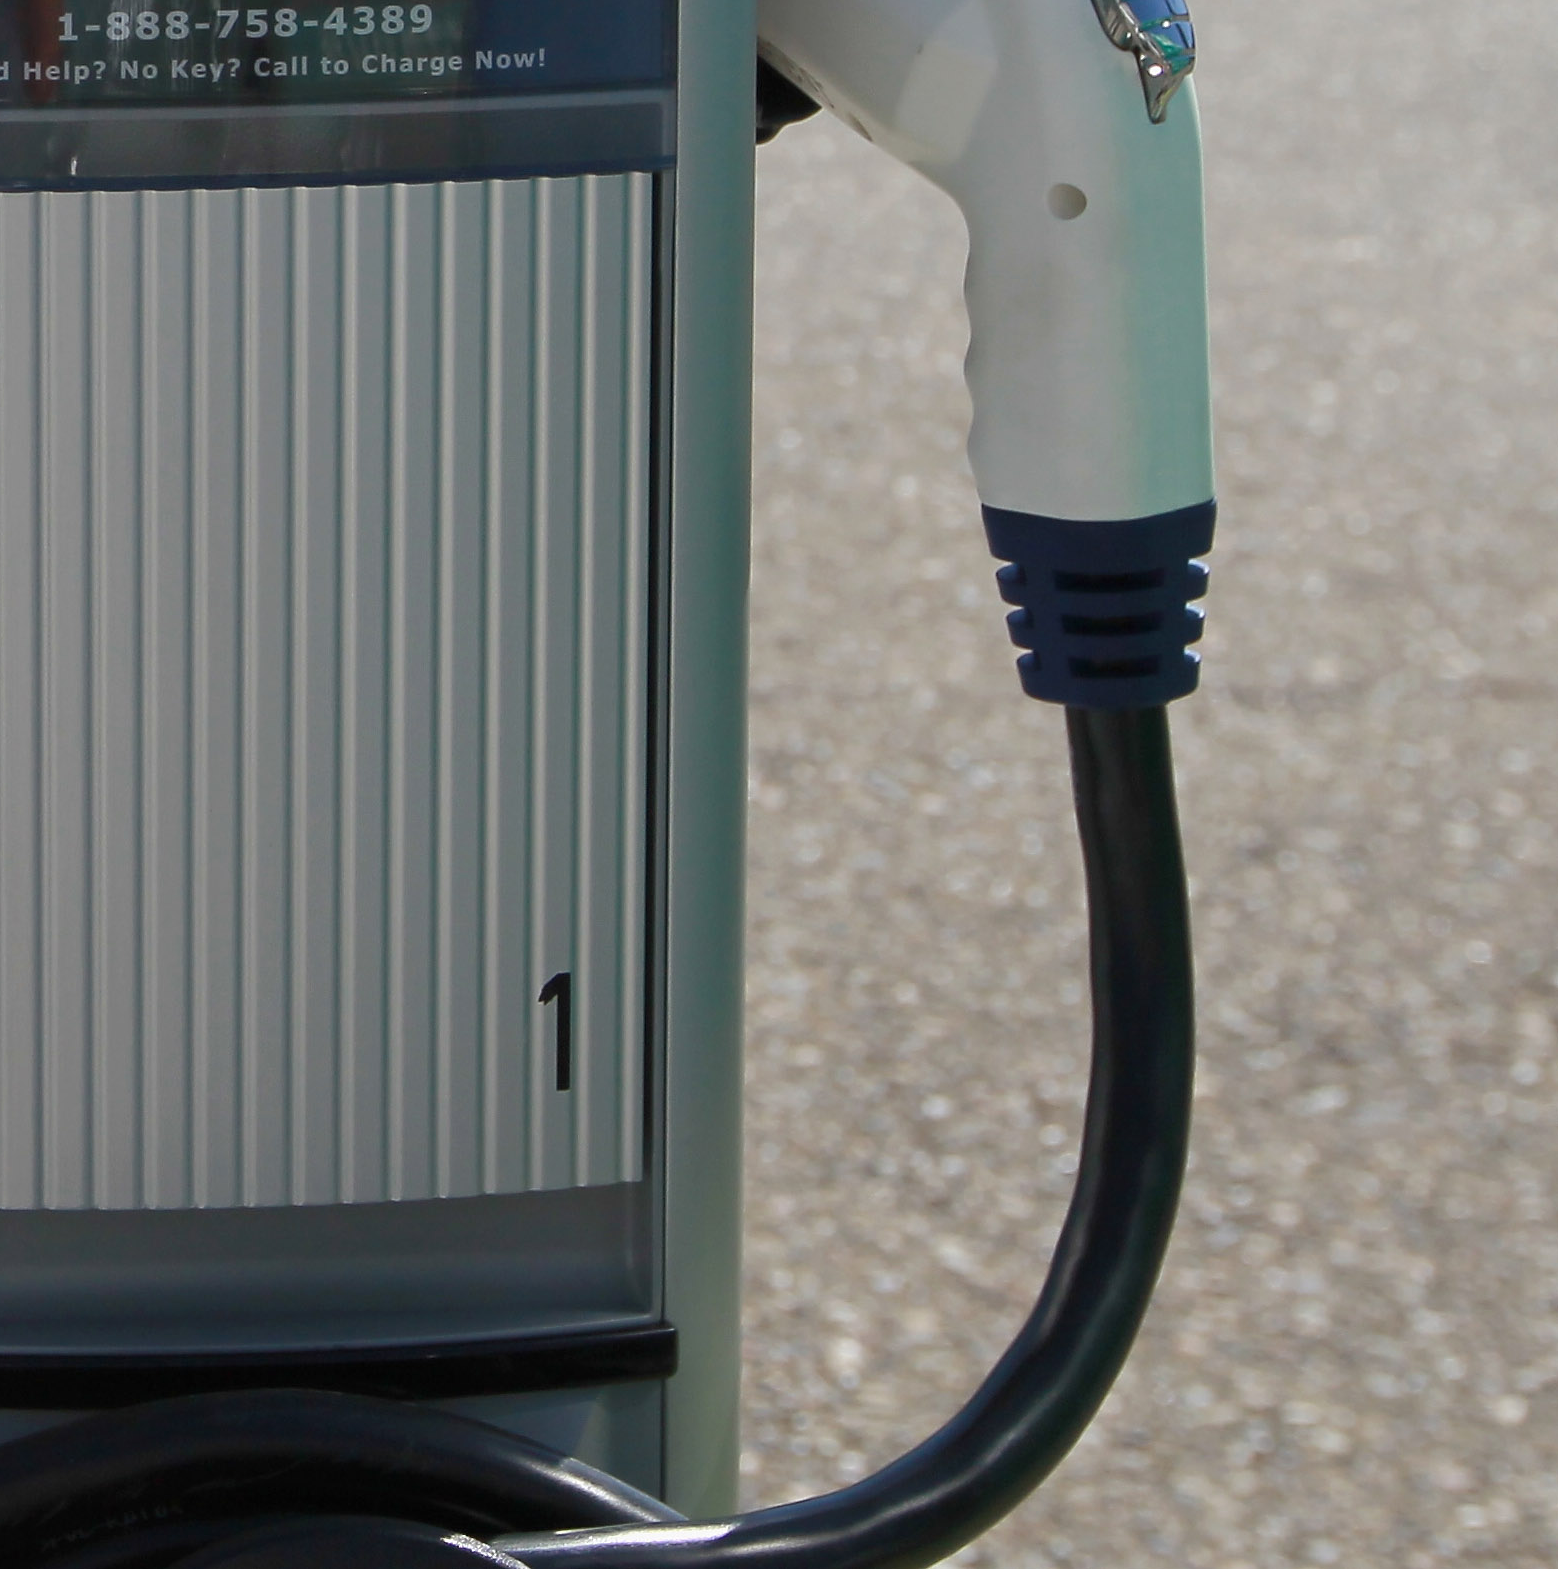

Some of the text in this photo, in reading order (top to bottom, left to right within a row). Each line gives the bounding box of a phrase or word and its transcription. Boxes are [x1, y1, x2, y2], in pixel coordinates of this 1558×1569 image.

[58, 4, 433, 42] 1-888-758-4389
[23, 60, 107, 84] Help?
[120, 60, 158, 79] No
[170, 58, 241, 83] Key?
[253, 56, 308, 77] Call
[320, 57, 350, 75] to
[361, 54, 463, 77] Charge
[475, 48, 546, 70] Now!
[537, 971, 571, 1092] 1
